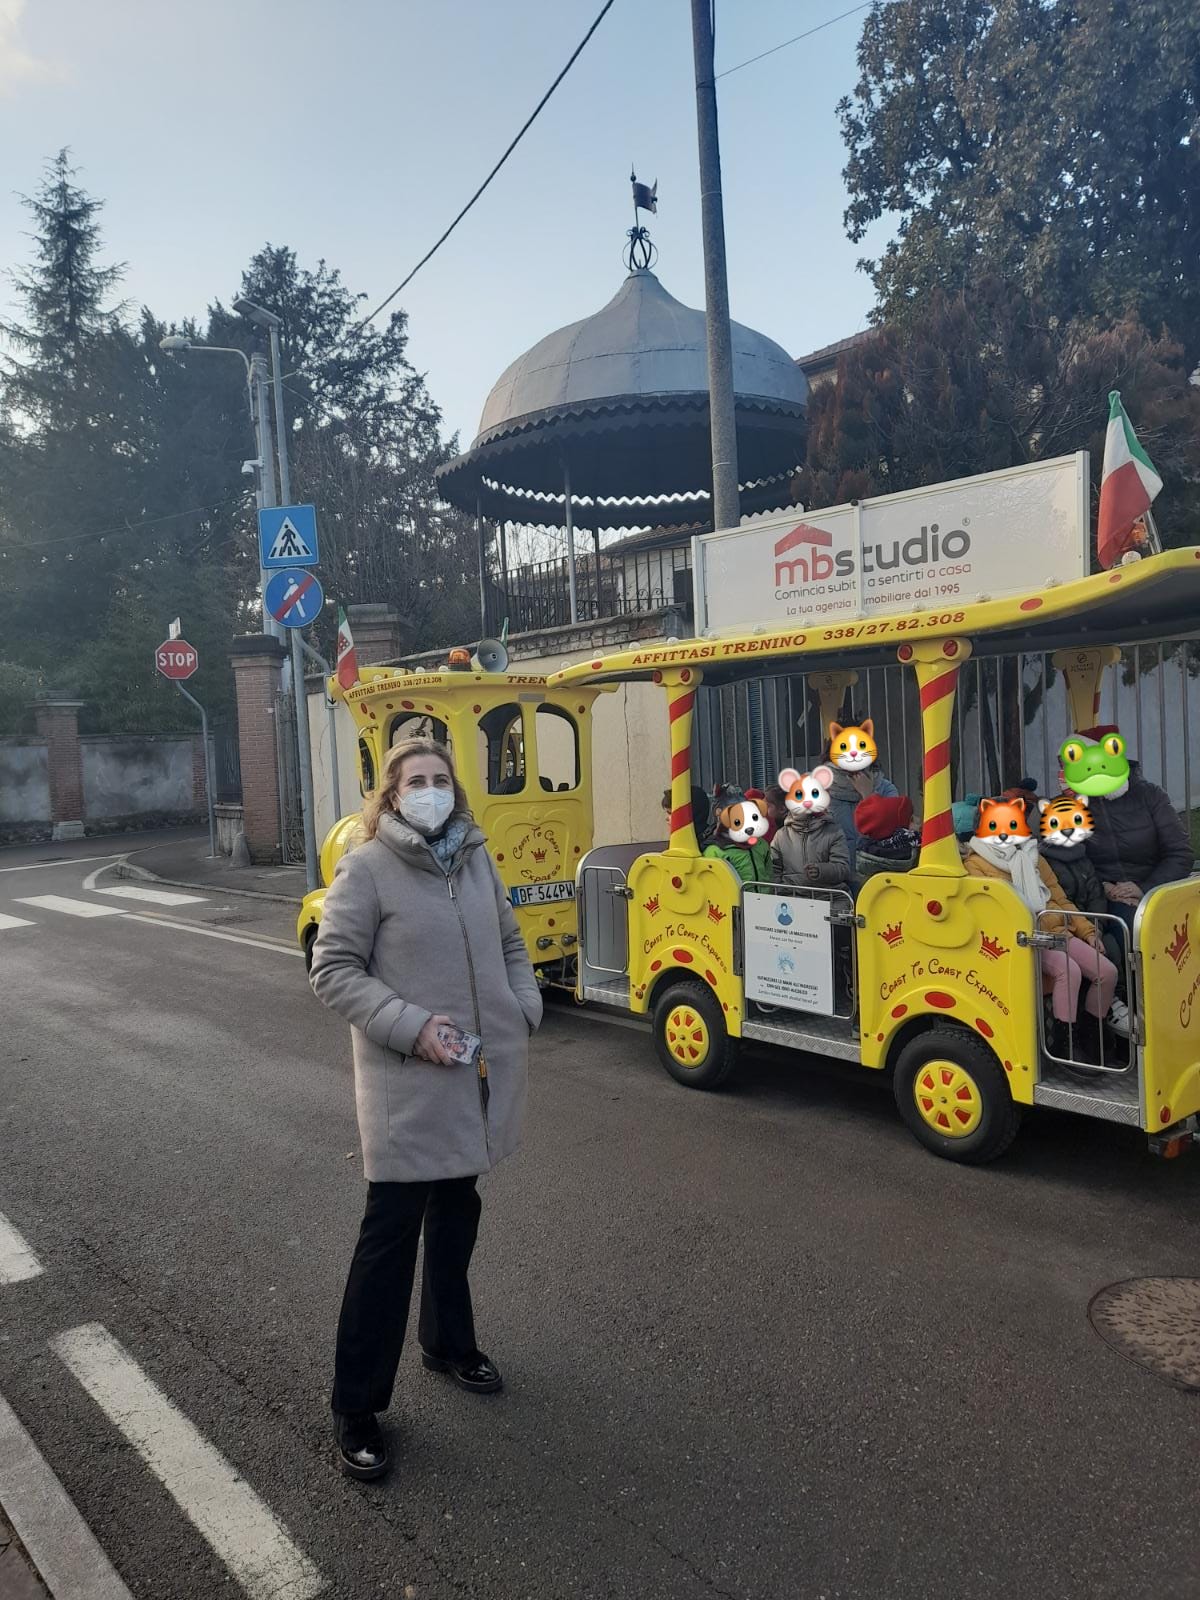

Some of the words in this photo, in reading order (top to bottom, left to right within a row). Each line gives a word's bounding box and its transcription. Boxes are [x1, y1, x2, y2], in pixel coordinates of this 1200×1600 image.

[775, 523, 971, 587] mbstudio
[775, 583, 826, 601] Comincia
[828, 579, 857, 592] subit
[868, 578, 876, 587] a
[878, 569, 924, 586] sentirti
[927, 569, 936, 578] a
[939, 564, 971, 577] casa
[786, 606, 797, 616] La
[798, 604, 814, 614] tua
[815, 600, 851, 612] agenzia
[853, 592, 912, 606] imobiliare
[914, 587, 931, 599] dal
[934, 583, 960, 596] 1995
[632, 646, 716, 664] AFFITTASI
[723, 634, 807, 655] TRENINO
[823, 611, 966, 641] 338/27.82.308
[158, 652, 195, 668] STOP
[348, 687, 376, 698] AFFITTASI
[507, 675, 548, 684] TREN
